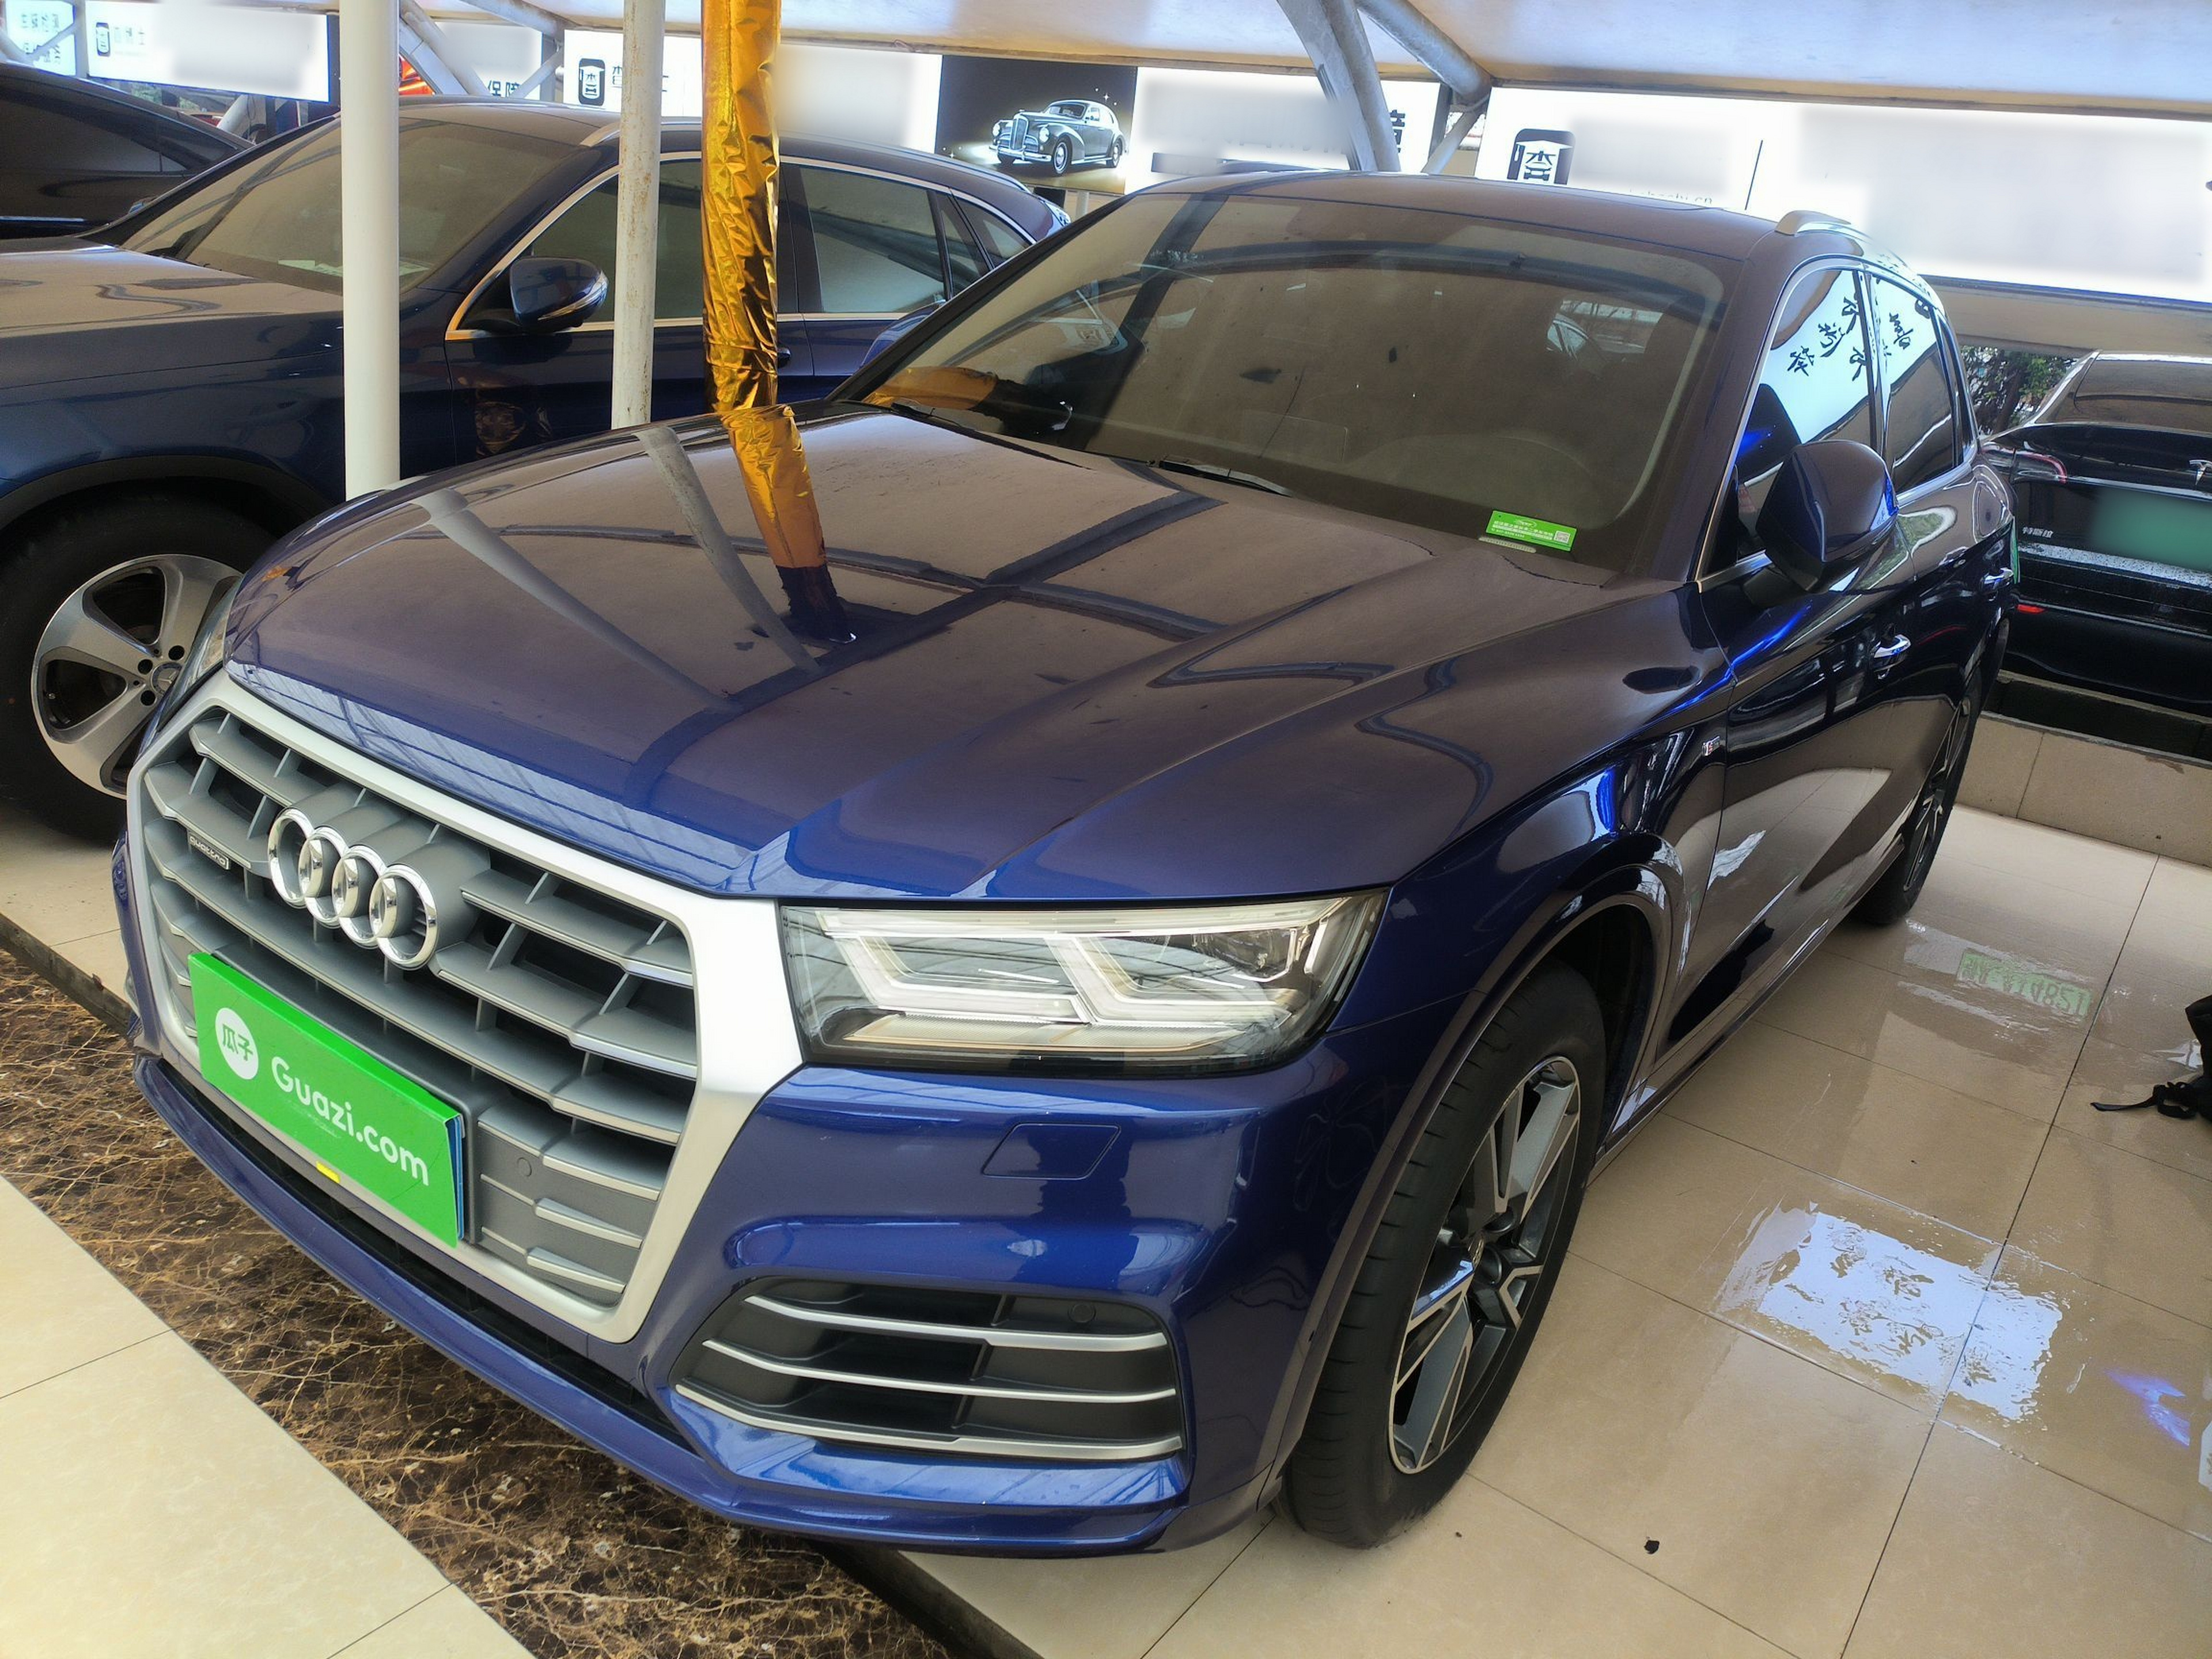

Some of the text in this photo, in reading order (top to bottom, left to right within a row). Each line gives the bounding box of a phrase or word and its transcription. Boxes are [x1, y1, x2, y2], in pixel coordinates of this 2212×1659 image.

[190, 835, 226, 866] quattro
[222, 1023, 254, 1062] 瓜子
[271, 1056, 429, 1187] Guazi.com
